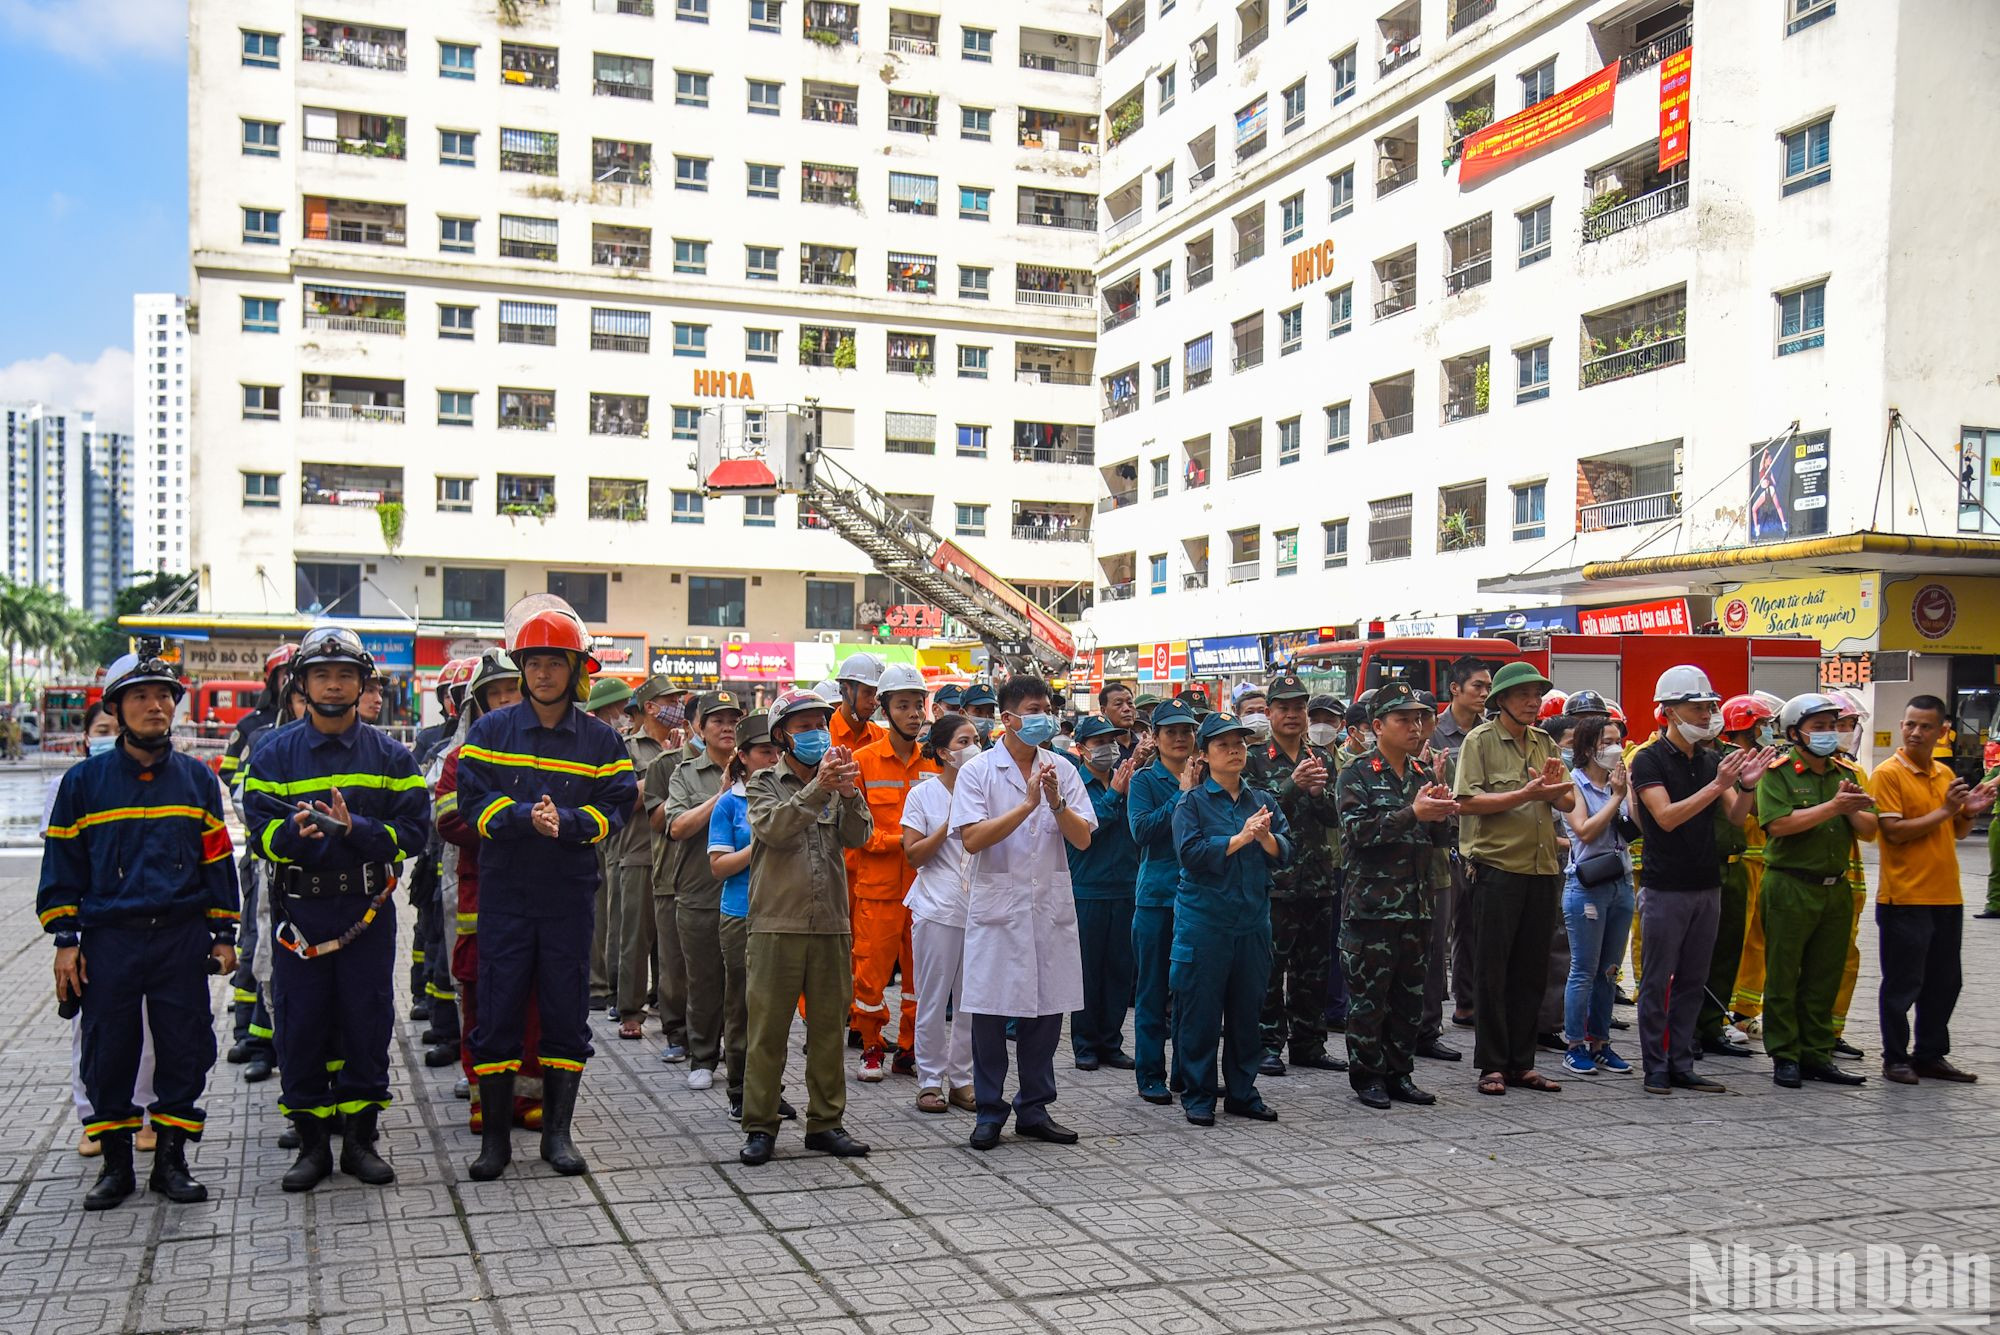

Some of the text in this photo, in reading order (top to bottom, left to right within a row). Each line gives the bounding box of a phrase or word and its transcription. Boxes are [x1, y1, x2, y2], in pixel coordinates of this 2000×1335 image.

[1291, 239, 1334, 291] HH1C
[694, 369, 755, 400] HH1A
[1807, 443, 1825, 454] DANCE
[885, 604, 942, 627] GYM
[1582, 613, 1599, 635] CỬA
[1599, 613, 1621, 634] HÀNG
[1639, 609, 1656, 629] ÍCH
[1655, 606, 1671, 628] GIÁ
[1670, 603, 1684, 625] RẺ
[1750, 596, 1786, 619] Ngon
[1801, 589, 1827, 606] chất
[1766, 613, 1800, 635] Sạch
[1816, 605, 1855, 629] nguồn
[191, 646, 217, 663] PHỞ
[221, 648, 238, 663] BÒ
[652, 654, 717, 675] CẮT TÓC NAM
